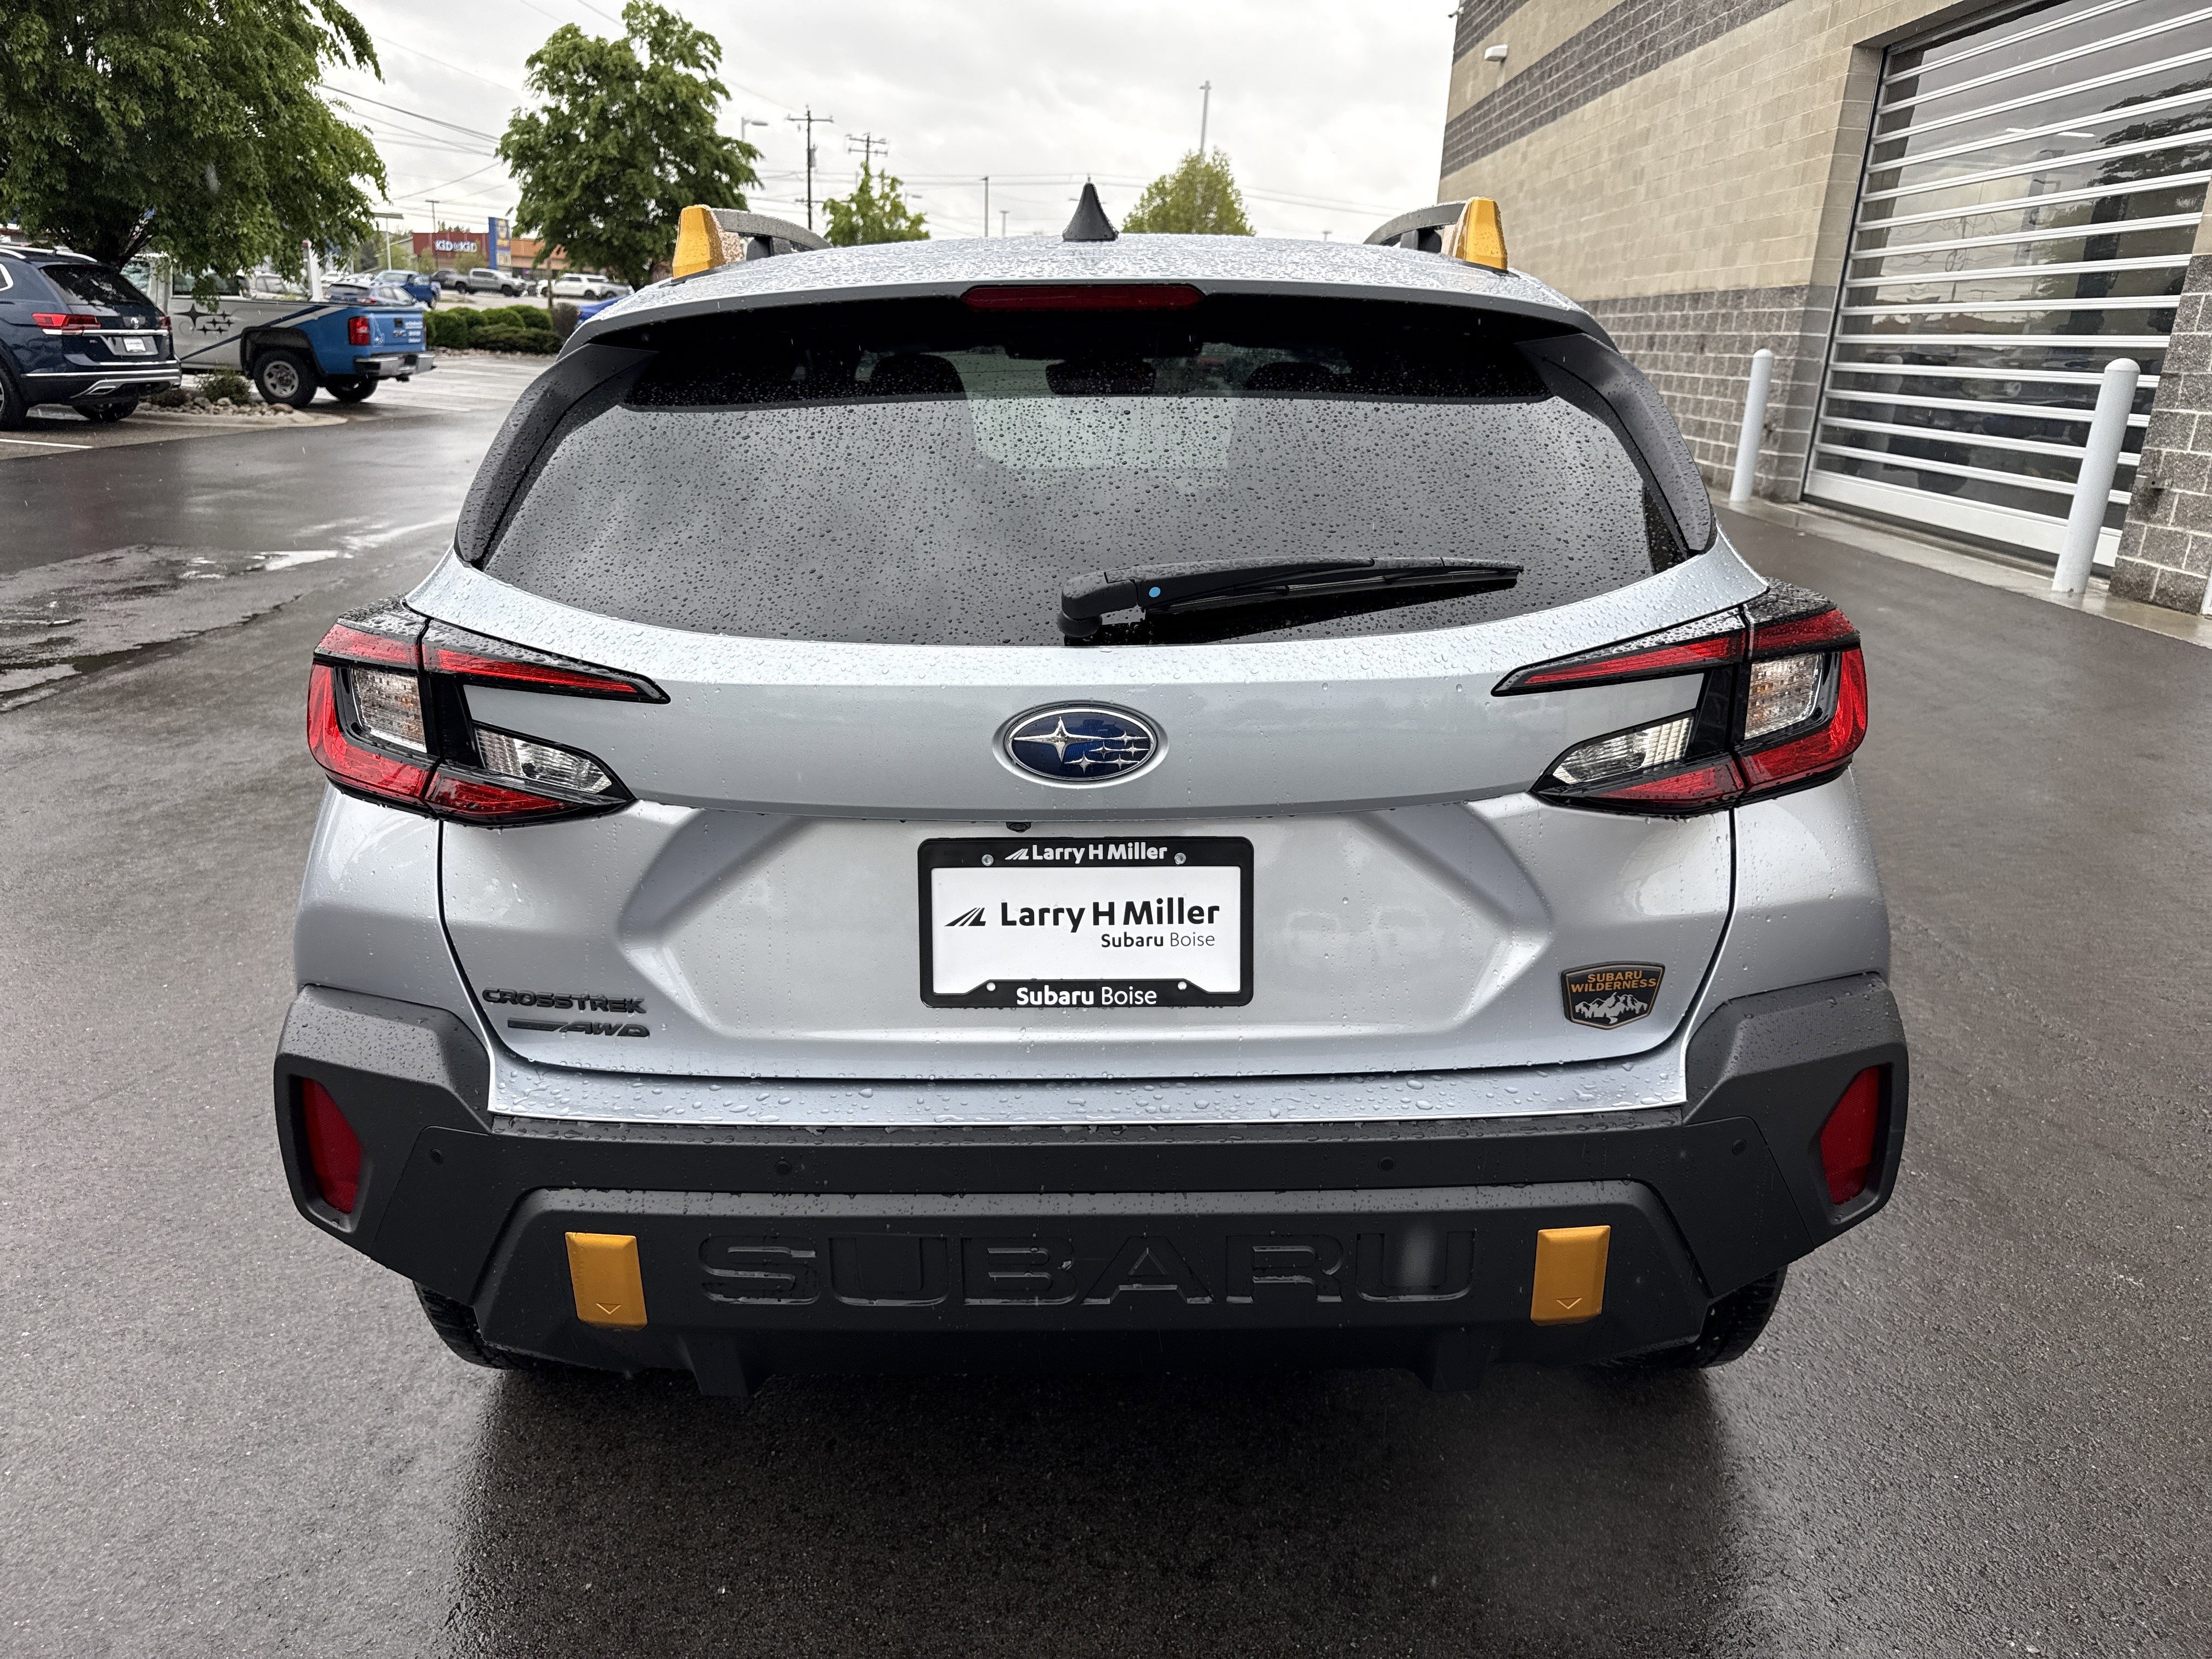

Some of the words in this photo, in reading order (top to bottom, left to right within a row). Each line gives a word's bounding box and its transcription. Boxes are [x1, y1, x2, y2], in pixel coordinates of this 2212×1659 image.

[1032, 844, 1086, 864] Larry
[1088, 844, 1104, 860] H
[1107, 842, 1167, 860] Miller
[1001, 902, 1086, 933] Larry
[1092, 901, 1115, 926] H
[1122, 897, 1220, 926] Miller
[1101, 931, 1164, 948] Subaru
[1170, 932, 1216, 947] Boise
[1571, 978, 1657, 993] WILDERNESS
[1587, 970, 1642, 983] SUBARU
[482, 988, 647, 1013] CROSSTREK
[1016, 985, 1094, 1006] Subaru
[1101, 986, 1157, 1005] Boise
[558, 1021, 650, 1037] AWD
[699, 1234, 1476, 1308] SUBARU
